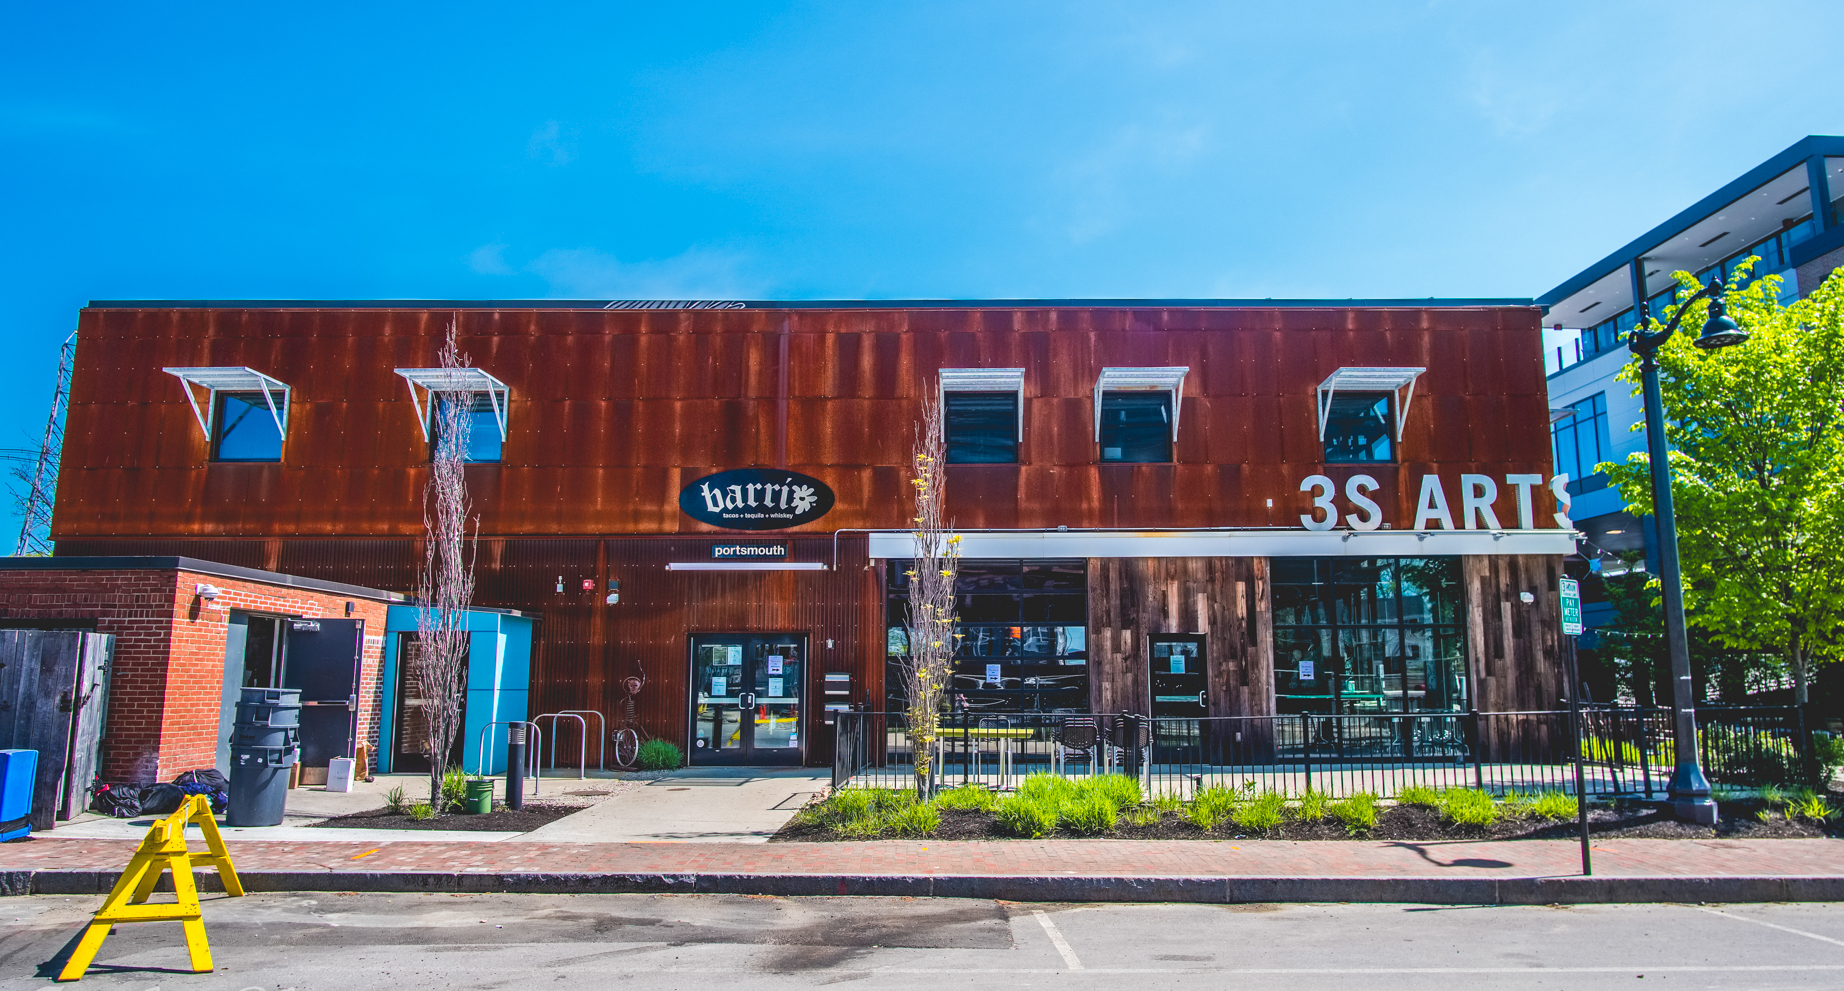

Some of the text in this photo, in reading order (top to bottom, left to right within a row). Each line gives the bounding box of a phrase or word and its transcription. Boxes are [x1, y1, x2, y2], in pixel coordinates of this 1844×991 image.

[1300, 474, 1383, 531] 3S
[745, 512, 765, 520] tequila
[770, 512, 794, 520] whiskey
[714, 545, 785, 558] portsmouth
[1566, 598, 1575, 607] PAY
[1564, 607, 1579, 617] METER
